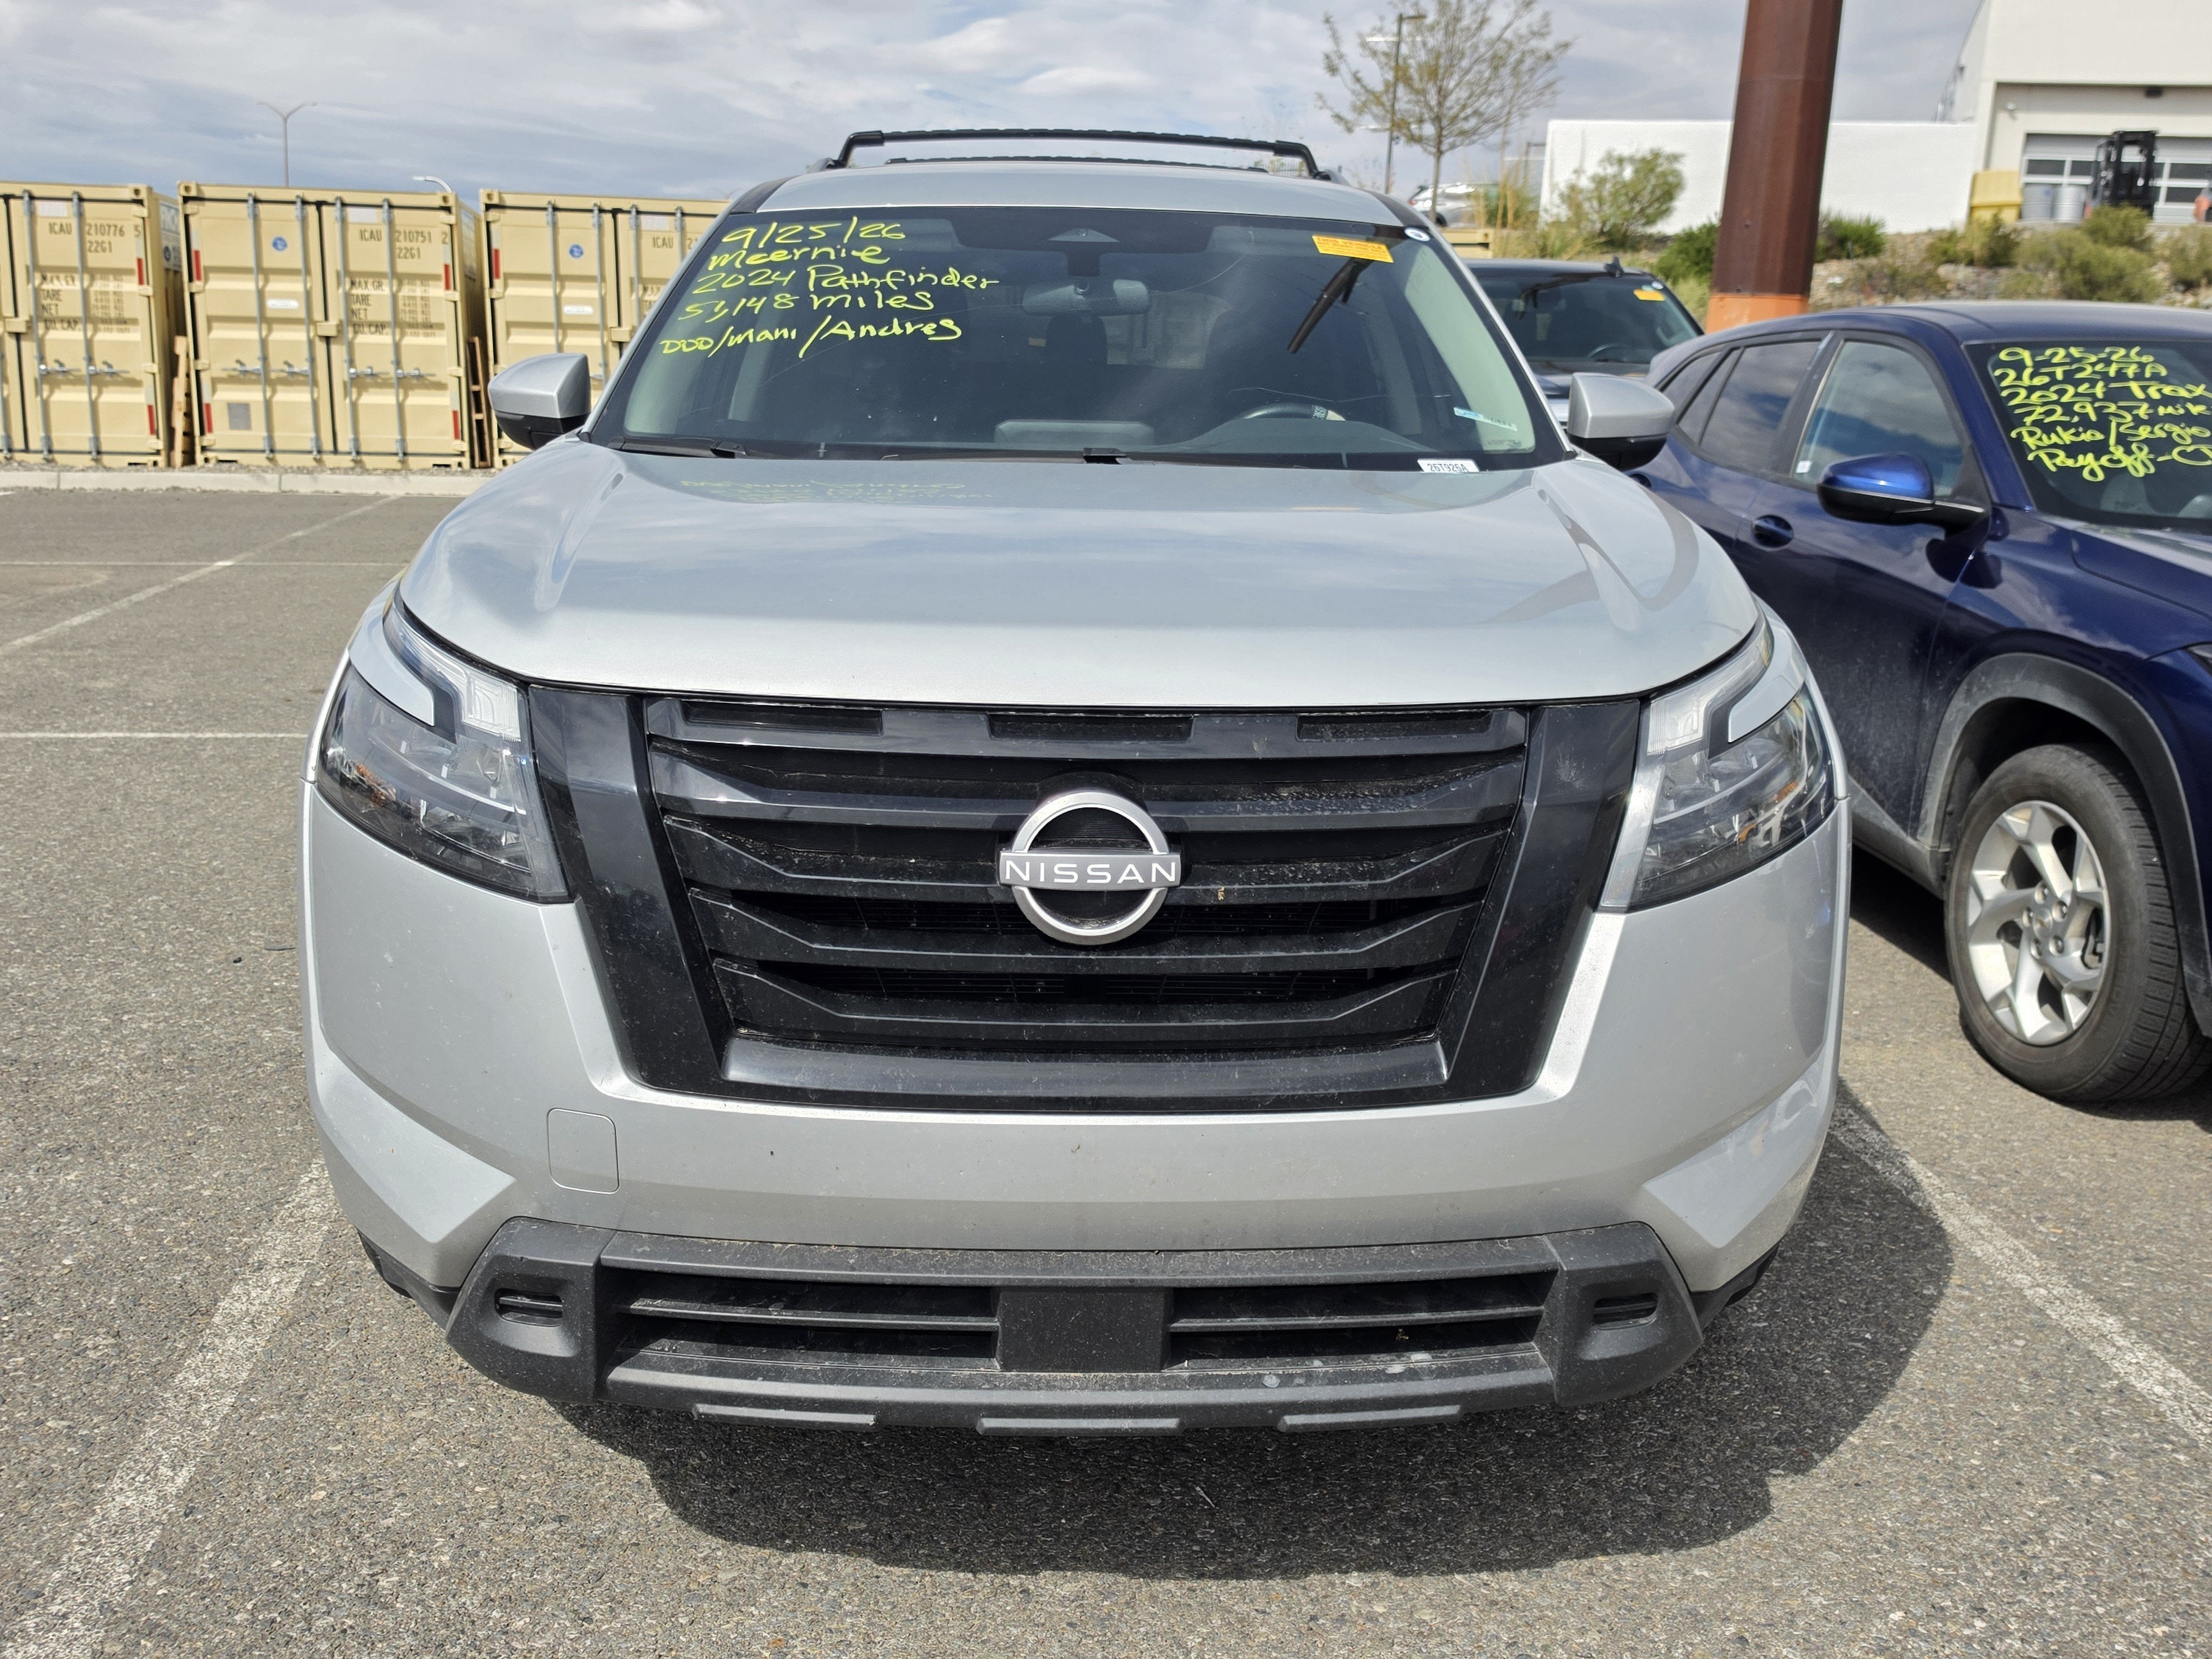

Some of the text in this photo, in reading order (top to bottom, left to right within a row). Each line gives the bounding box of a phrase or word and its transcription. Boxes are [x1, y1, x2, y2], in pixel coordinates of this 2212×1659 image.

[49, 222, 72, 235] ICAU
[86, 222, 126, 237] 210776
[359, 229, 382, 242] ICAU
[722, 216, 906, 249] 9/25/26
[652, 236, 674, 249] ICAU
[692, 269, 796, 294] 2024
[2000, 380, 2107, 406] 2024
[2013, 400, 2154, 427] 72,937
[1427, 463, 1469, 473] 26T926A
[1005, 860, 1176, 884] NISSAN
